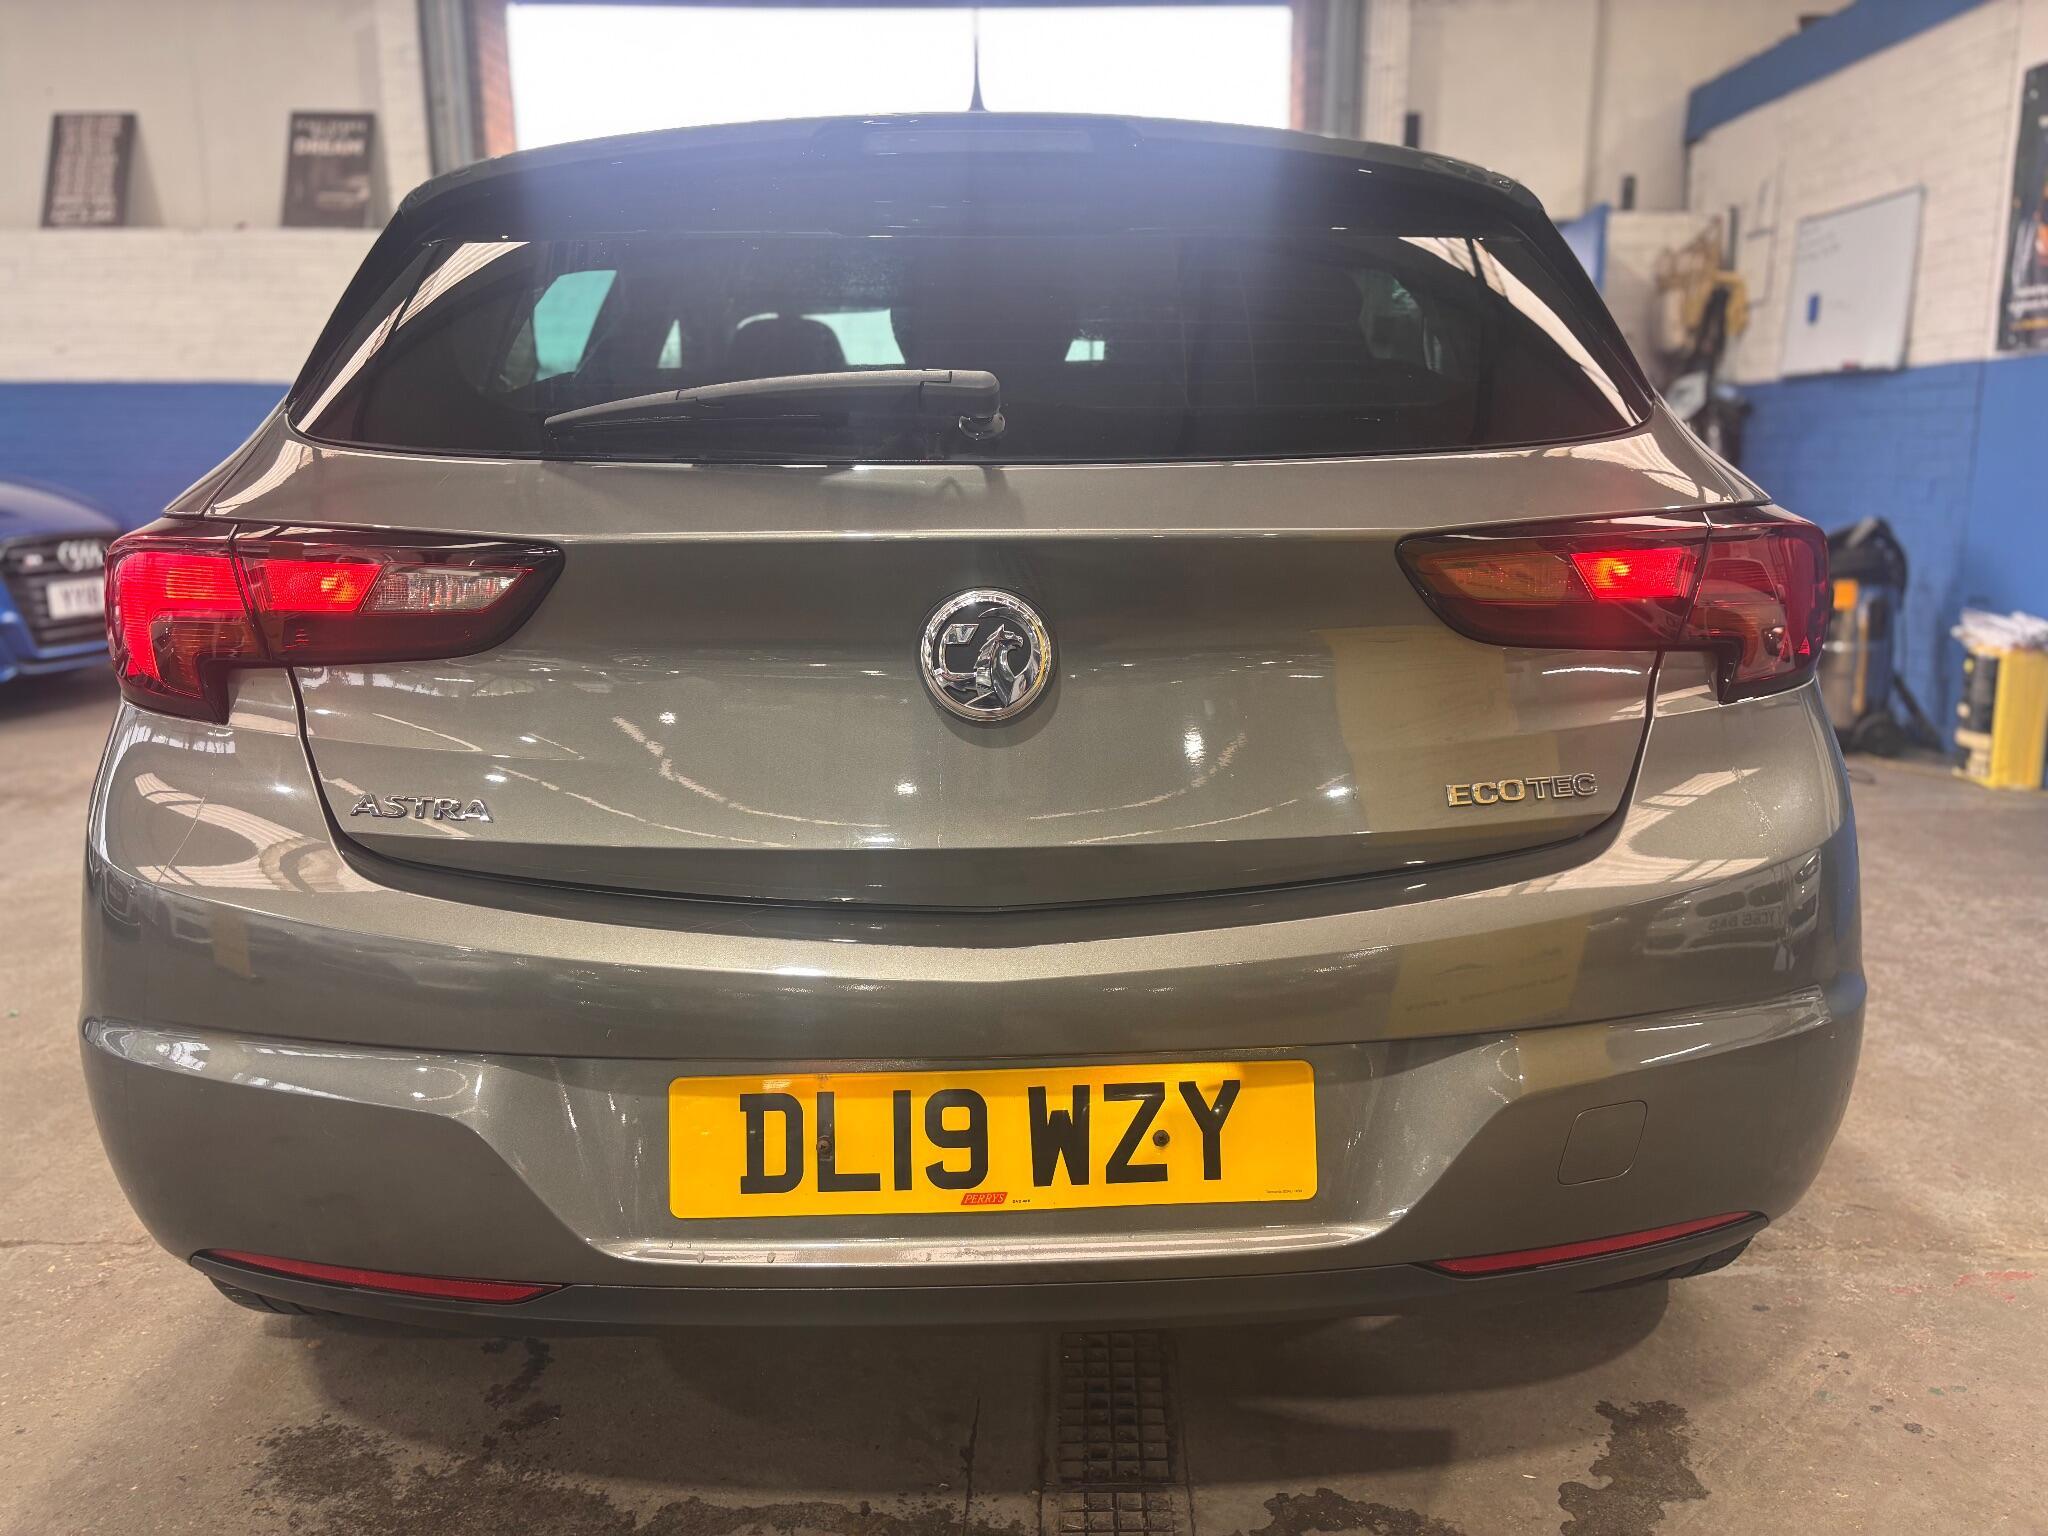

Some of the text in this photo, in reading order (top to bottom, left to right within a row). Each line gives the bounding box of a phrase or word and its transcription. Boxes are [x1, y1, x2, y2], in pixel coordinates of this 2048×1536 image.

[1446, 772, 1598, 807] ECOTEC
[350, 794, 493, 823] ASTRA
[740, 1079, 1241, 1195] DL19 WZY
[964, 1193, 1005, 1204] PERRYS
